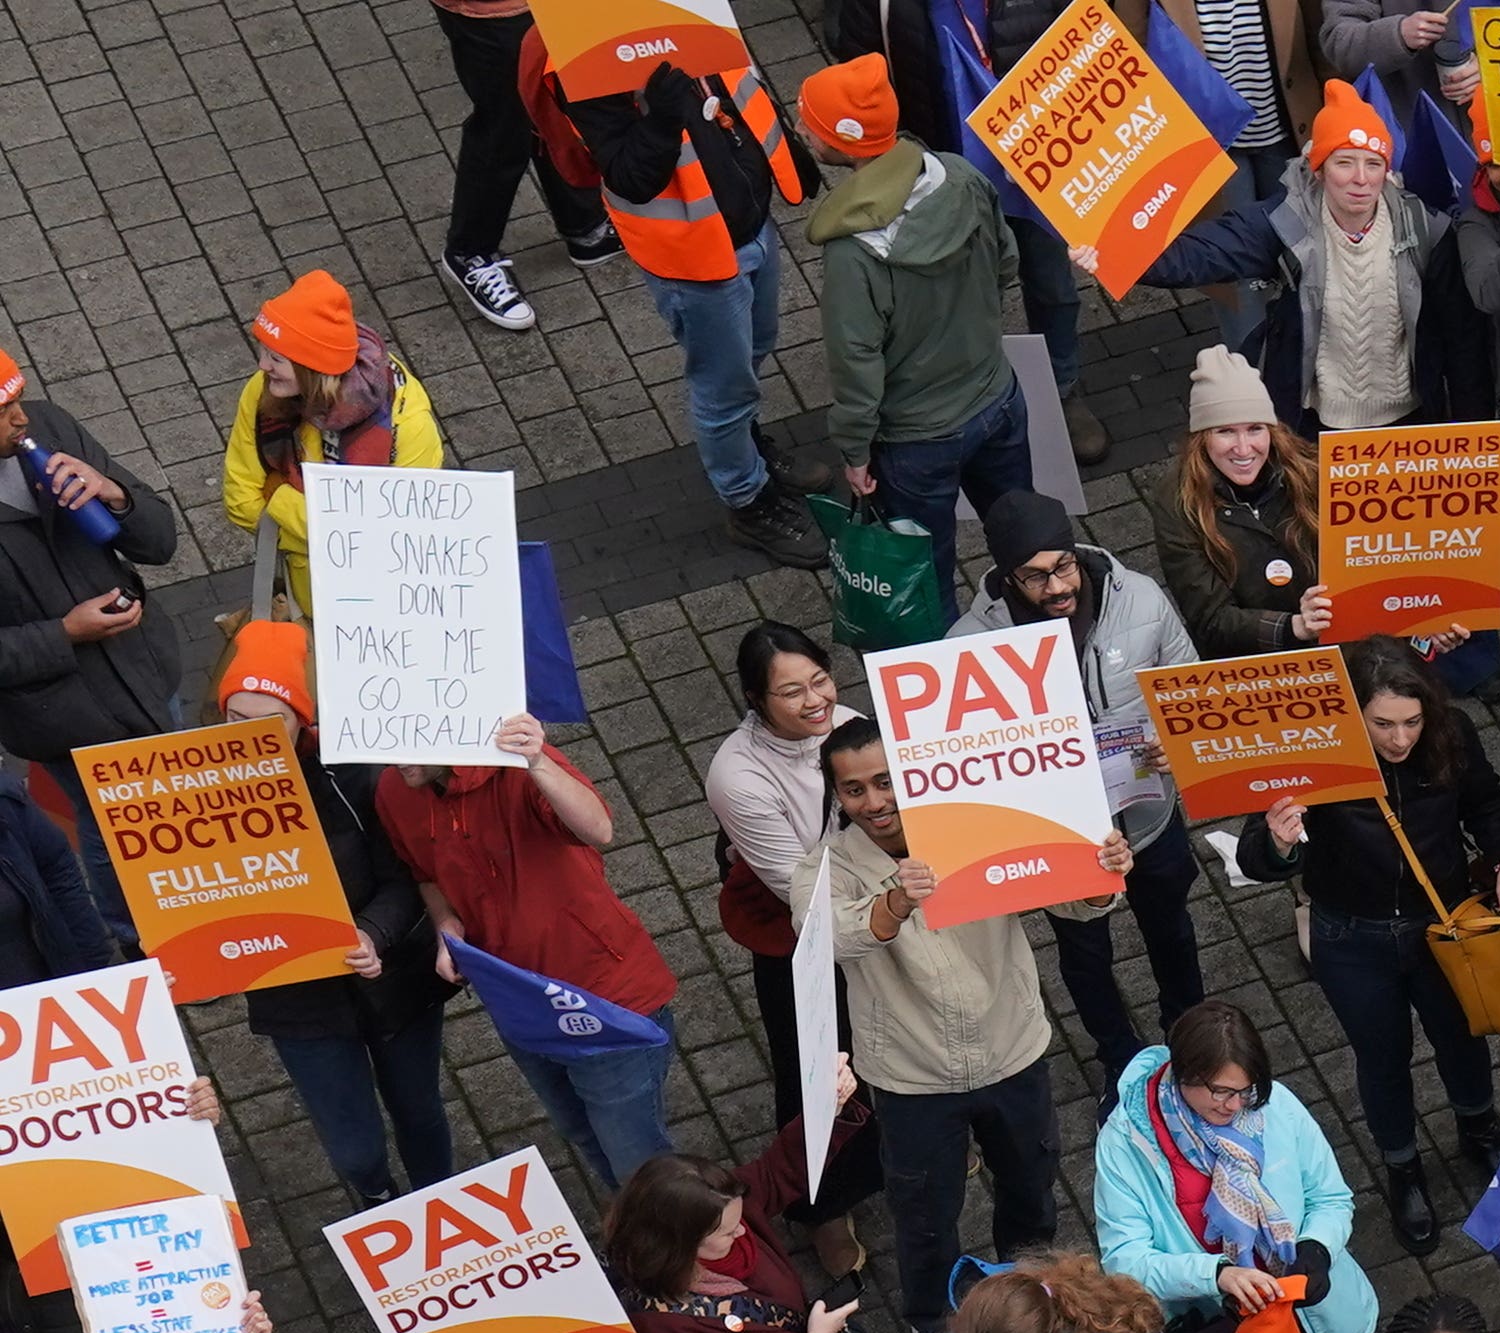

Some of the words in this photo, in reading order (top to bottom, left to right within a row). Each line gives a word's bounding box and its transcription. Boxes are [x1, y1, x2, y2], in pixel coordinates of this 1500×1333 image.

[320, 478, 363, 516] I'M
[378, 479, 472, 520] SCARED
[327, 530, 362, 568] OF
[388, 531, 492, 576] SNAKES
[336, 625, 418, 668] MAKE
[444, 629, 485, 673] ME
[359, 675, 400, 711] GO
[427, 678, 467, 709] TO
